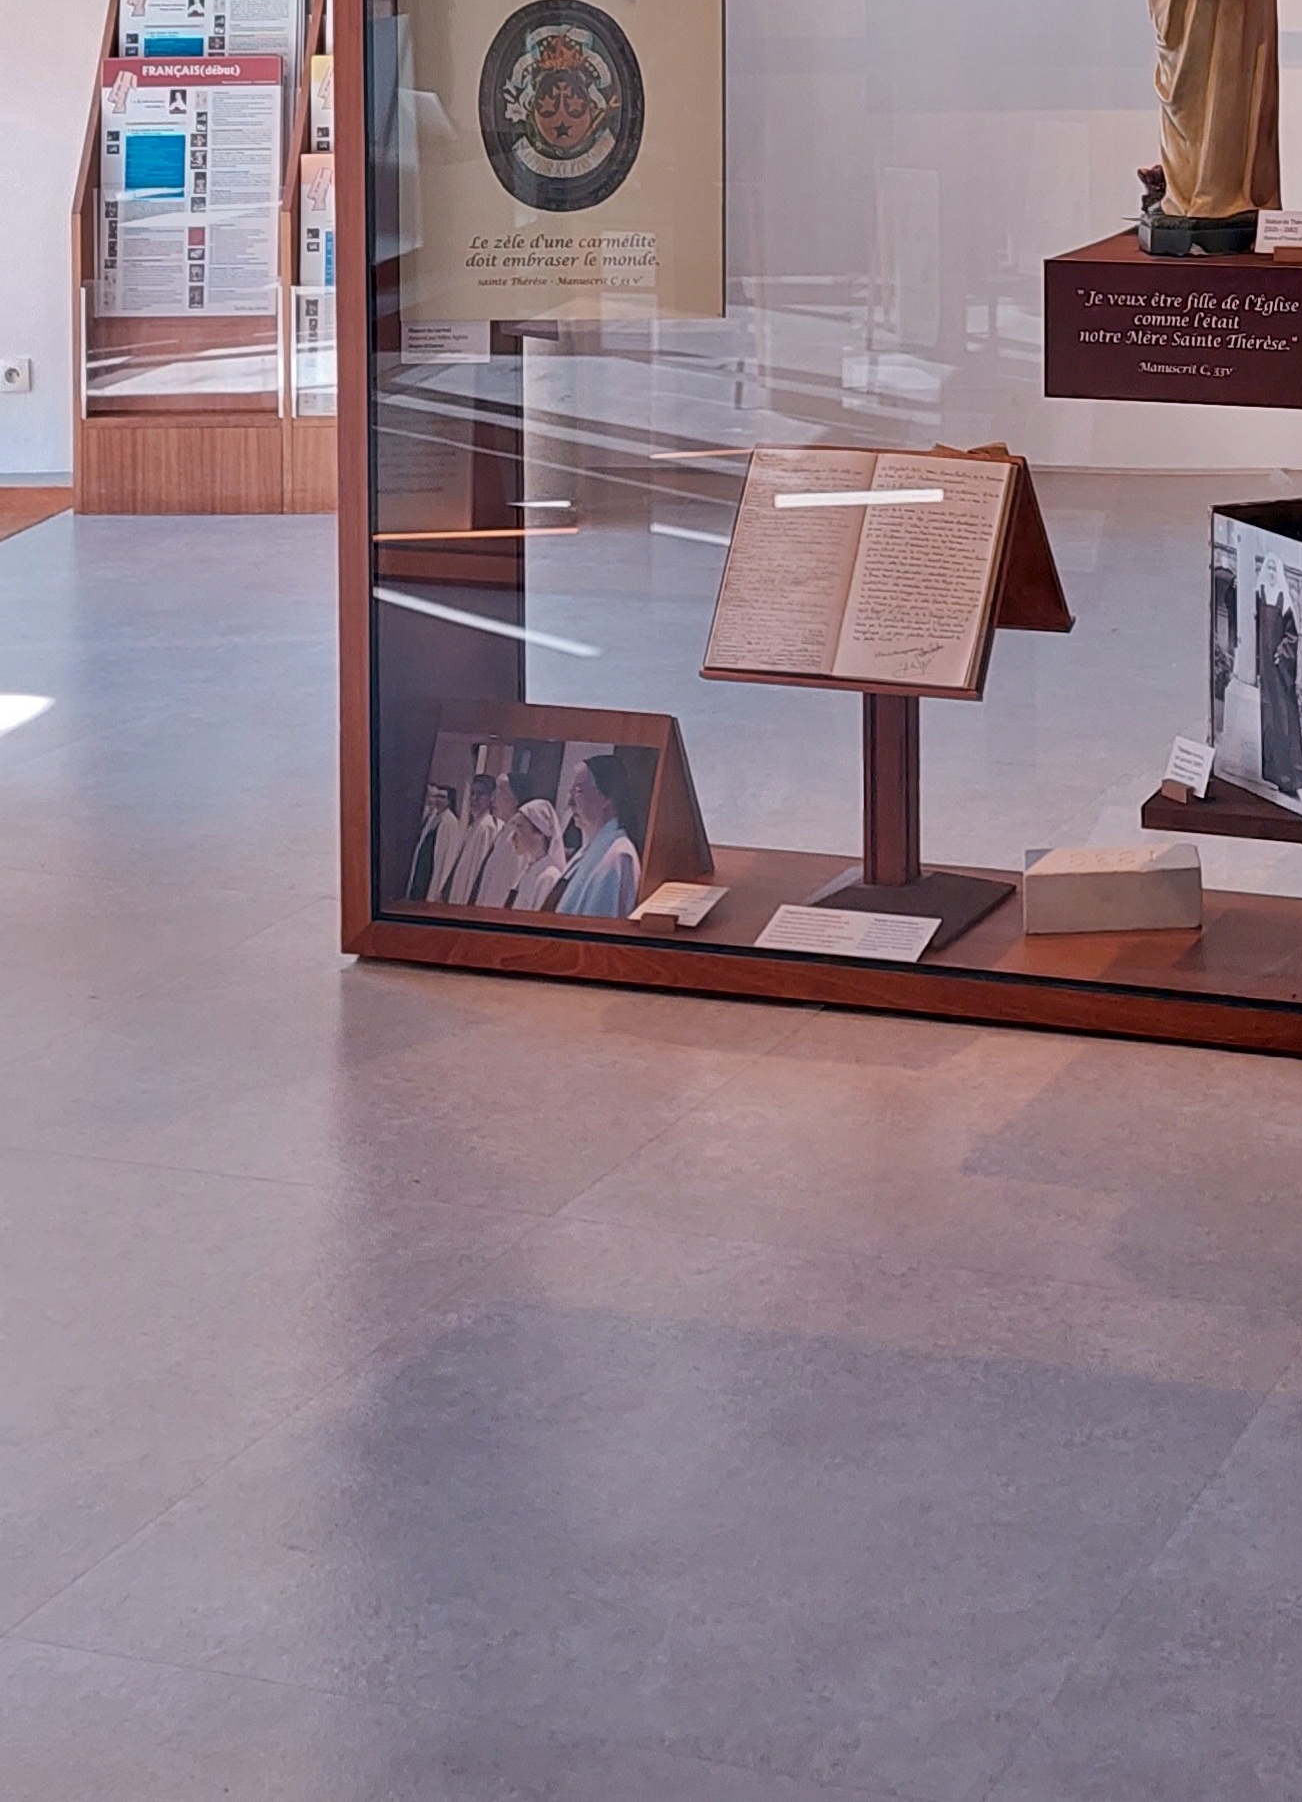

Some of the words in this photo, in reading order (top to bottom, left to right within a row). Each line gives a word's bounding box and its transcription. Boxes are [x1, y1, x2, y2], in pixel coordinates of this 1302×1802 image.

[468, 235, 489, 249] Le
[492, 233, 525, 249] zèle
[529, 233, 573, 249] d'une
[577, 233, 656, 248] carmélite
[464, 251, 497, 267] doit
[501, 250, 579, 267] embraser
[582, 250, 597, 267] le
[602, 250, 660, 267] monde.
[1084, 290, 1103, 306] Je
[1106, 293, 1147, 306] veux
[1150, 291, 1182, 308] être
[1184, 291, 1217, 313] fille
[1220, 293, 1240, 310] de
[1133, 314, 1189, 327] comme
[1079, 329, 1121, 343] notre
[1124, 329, 1167, 345] Mère
[1170, 331, 1221, 347] Sainte
